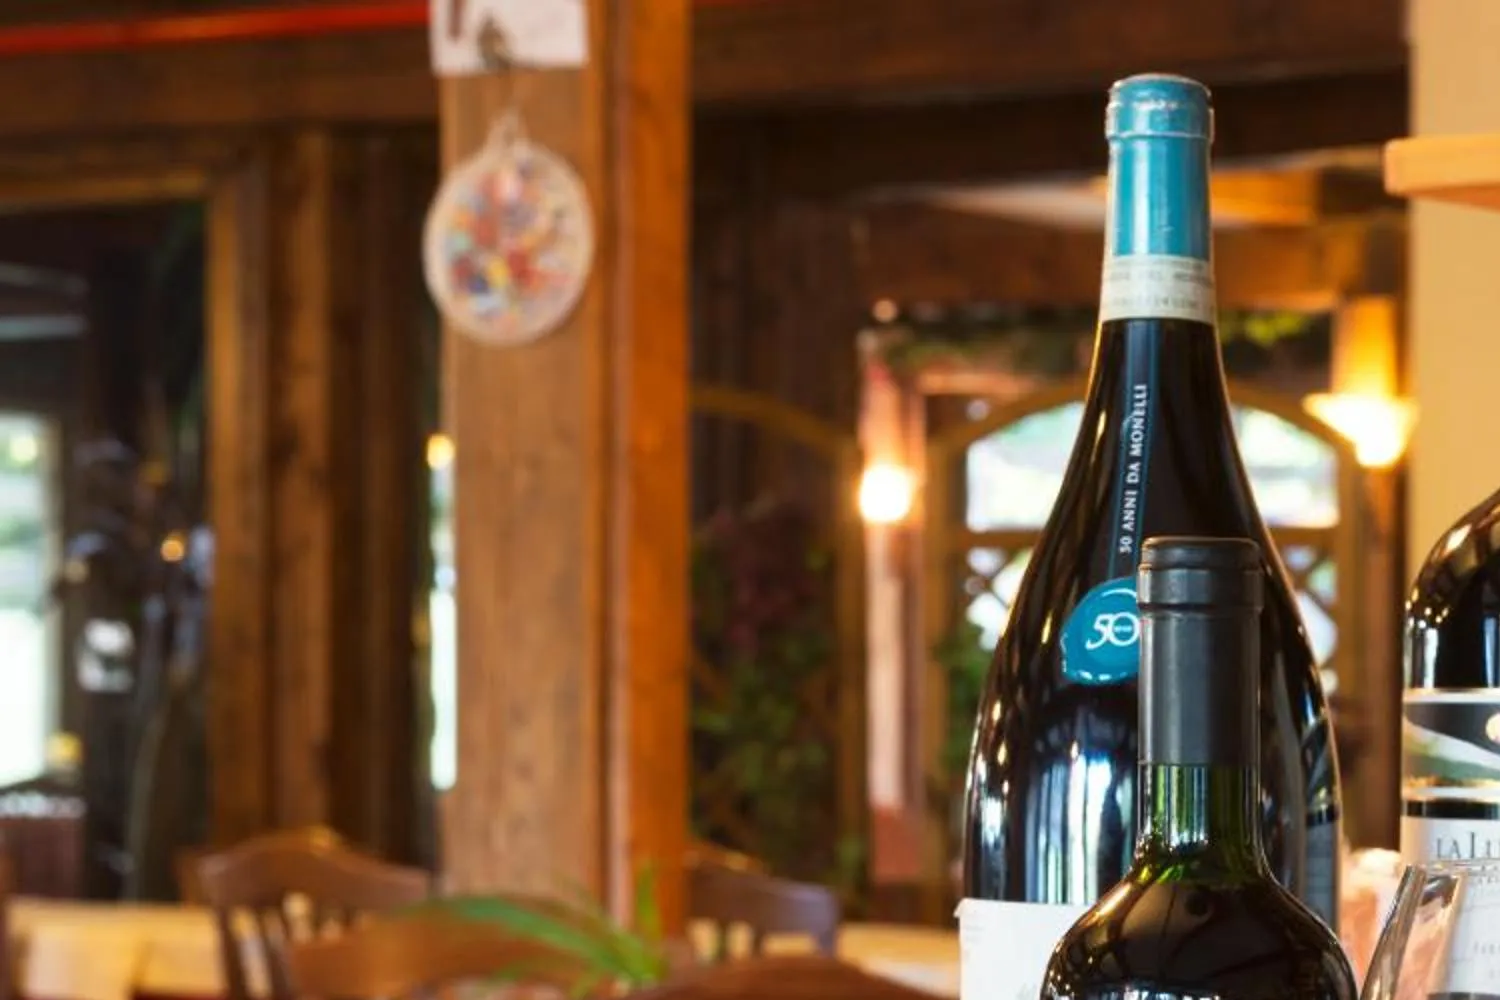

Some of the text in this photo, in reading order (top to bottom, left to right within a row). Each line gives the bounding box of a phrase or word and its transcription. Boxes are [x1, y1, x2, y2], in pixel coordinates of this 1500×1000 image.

[1126, 461, 1141, 484] DA
[1121, 489, 1138, 532] ANNI
[1085, 611, 1139, 650] 50
